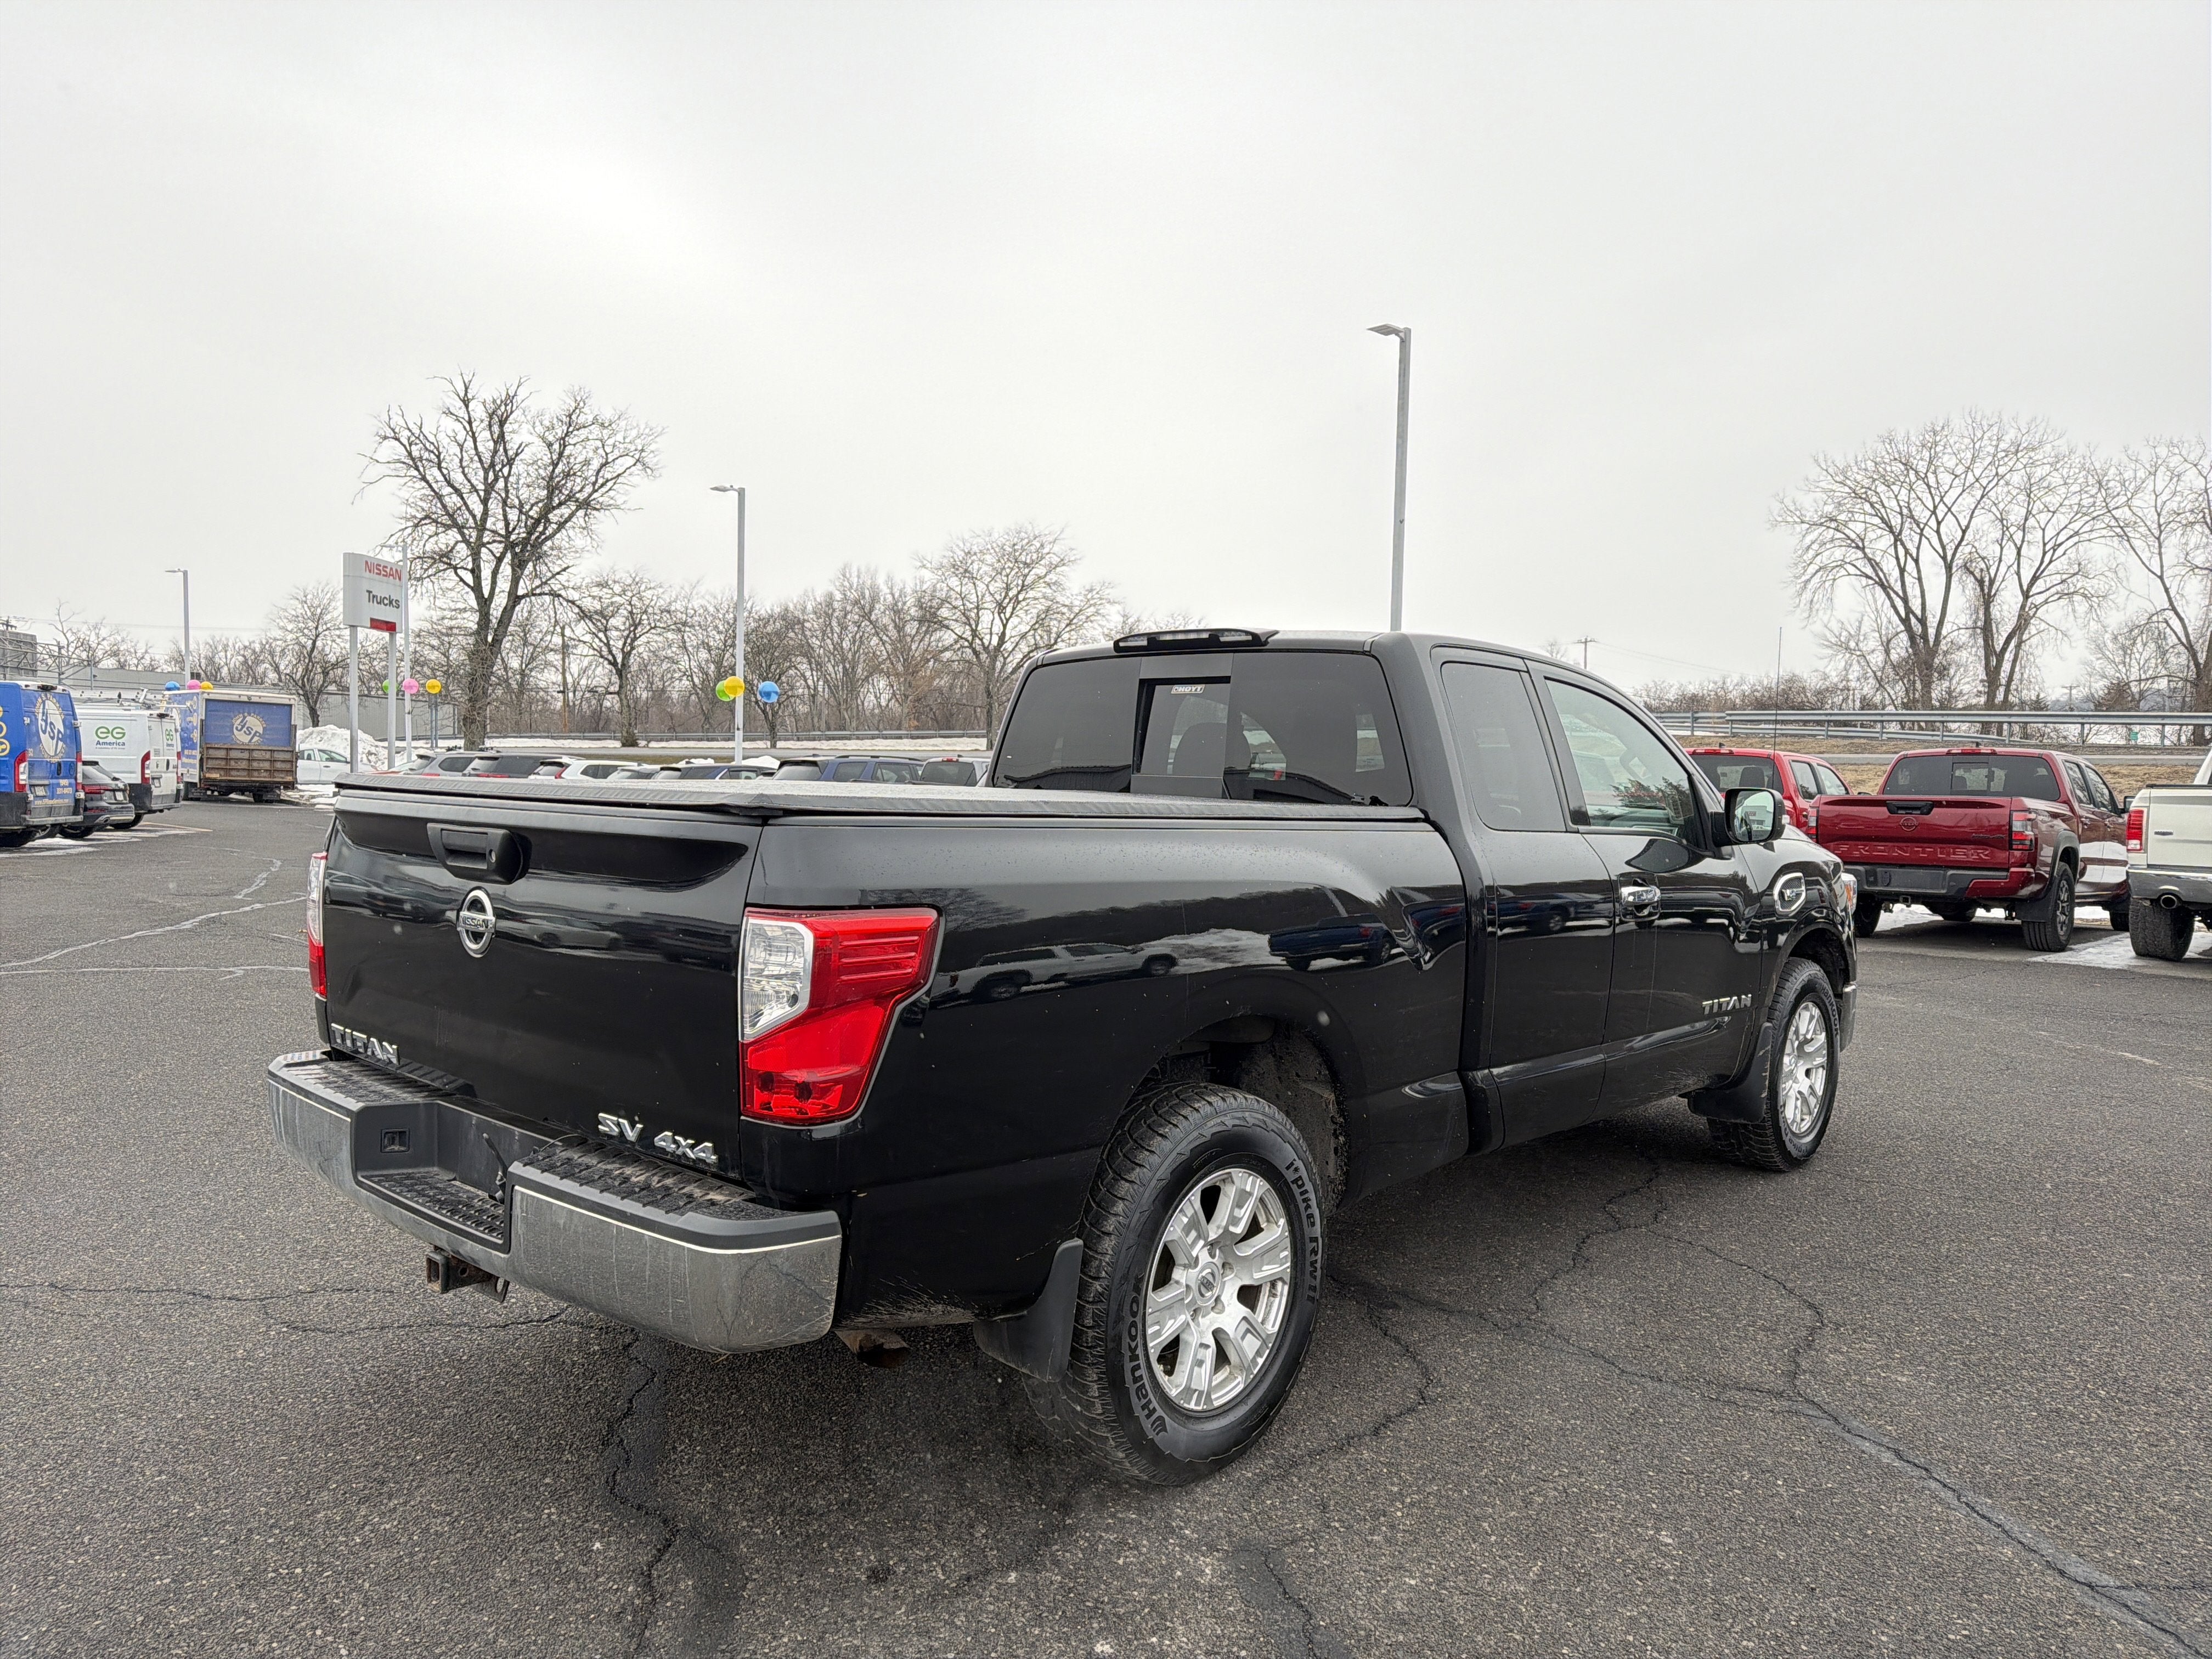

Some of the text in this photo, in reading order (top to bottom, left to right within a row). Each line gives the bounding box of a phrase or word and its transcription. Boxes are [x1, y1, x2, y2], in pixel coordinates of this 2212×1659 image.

[365, 560, 402, 582] NISSAN
[366, 589, 400, 609] Trucks
[461, 915, 489, 930] NISSAN
[1702, 994, 1752, 1015] TITAN
[331, 1023, 399, 1065] TITAN
[598, 1113, 644, 1142] SV
